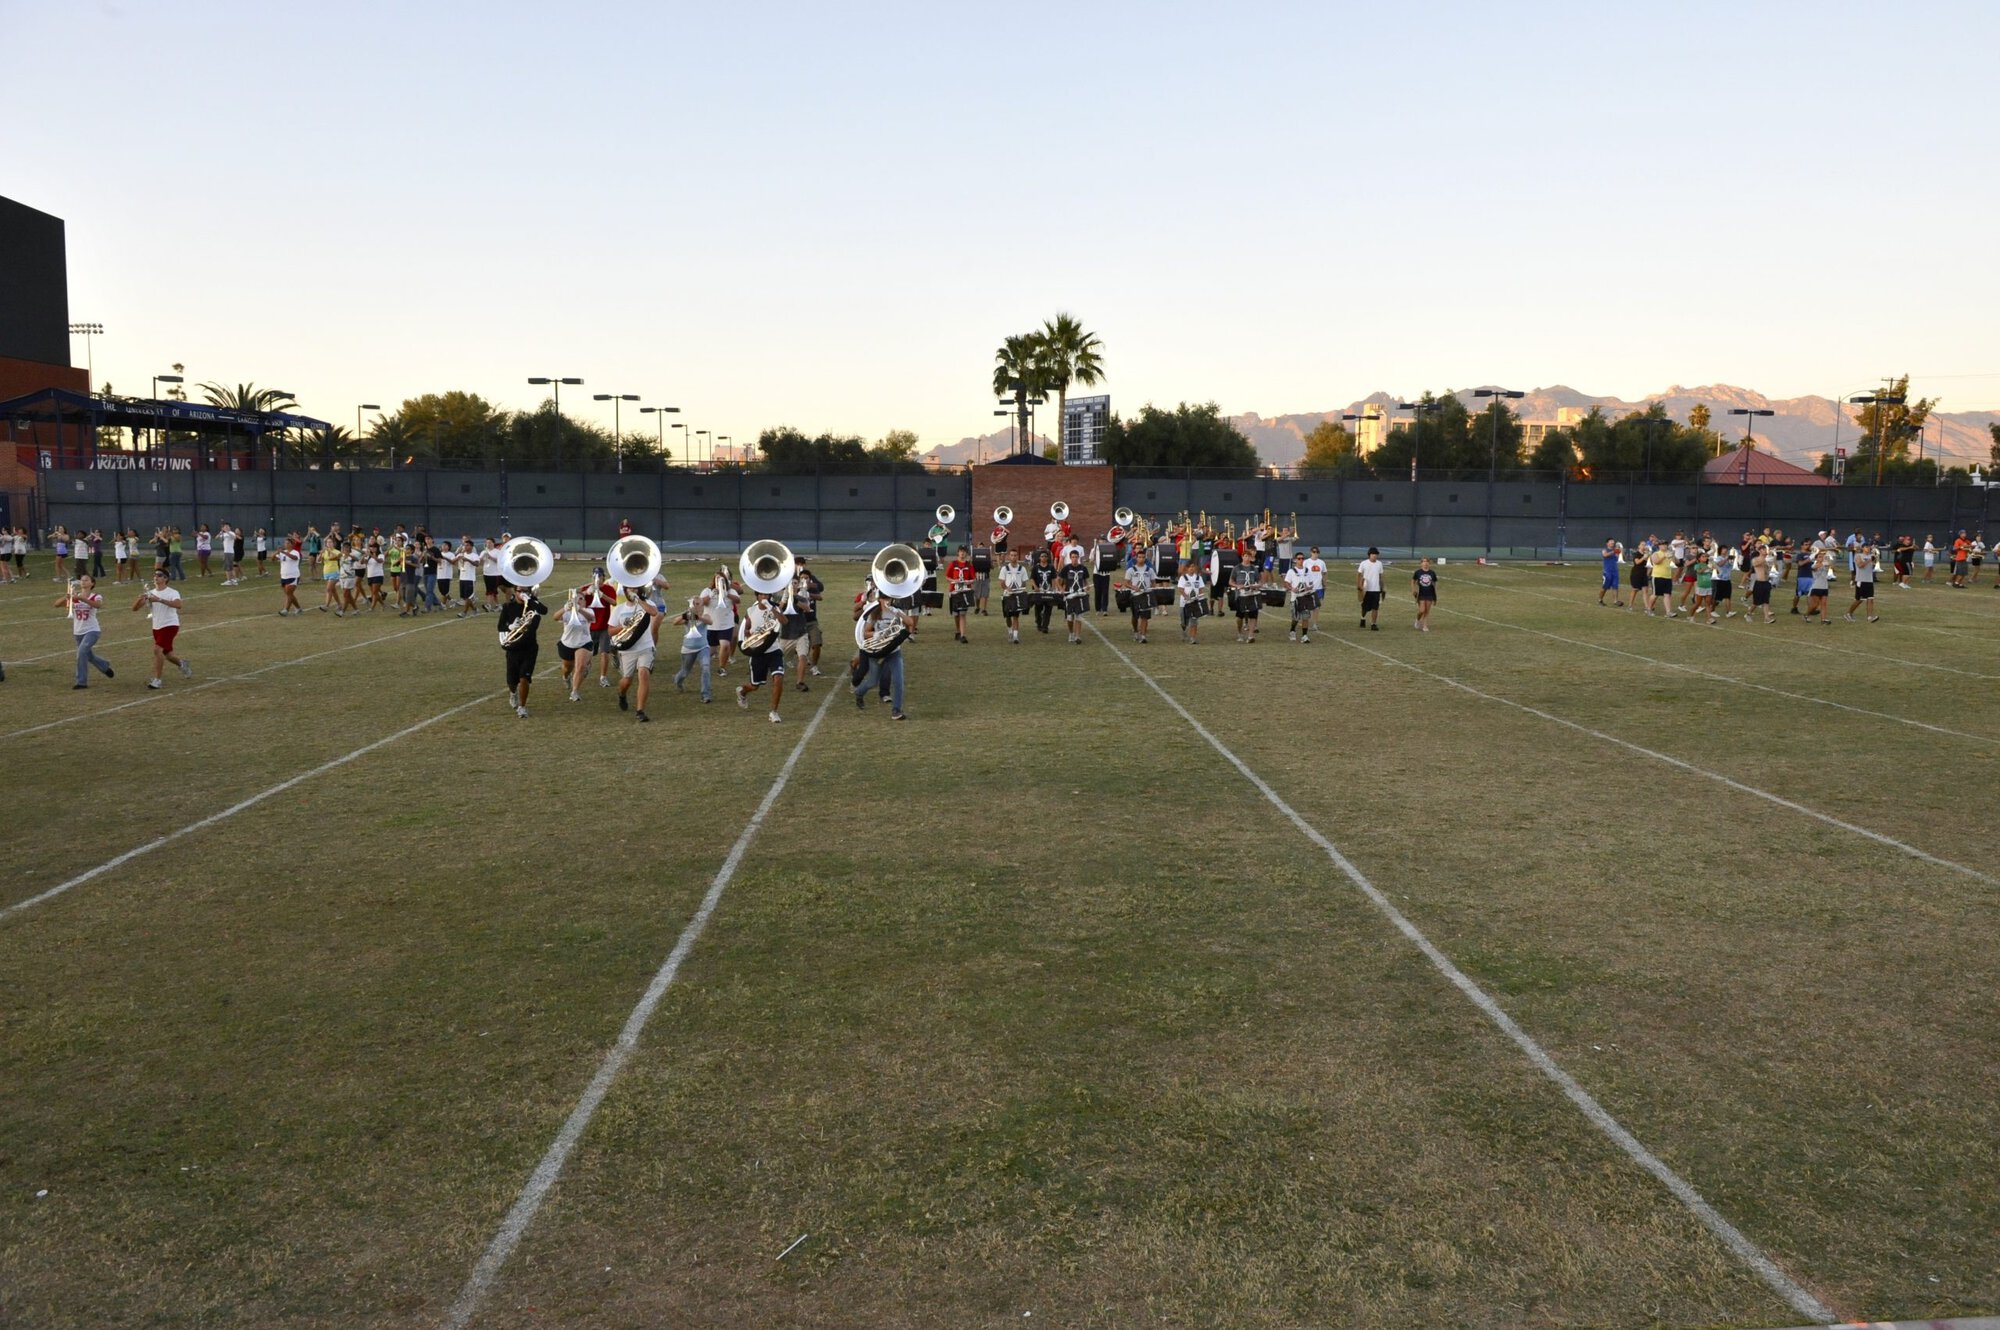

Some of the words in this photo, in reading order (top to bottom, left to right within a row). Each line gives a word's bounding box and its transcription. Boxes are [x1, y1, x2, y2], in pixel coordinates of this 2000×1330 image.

[102, 401, 116, 411] THE
[125, 406, 163, 416] UNIVERSTY
[172, 408, 180, 417] OF
[189, 410, 215, 420] ARIZONA
